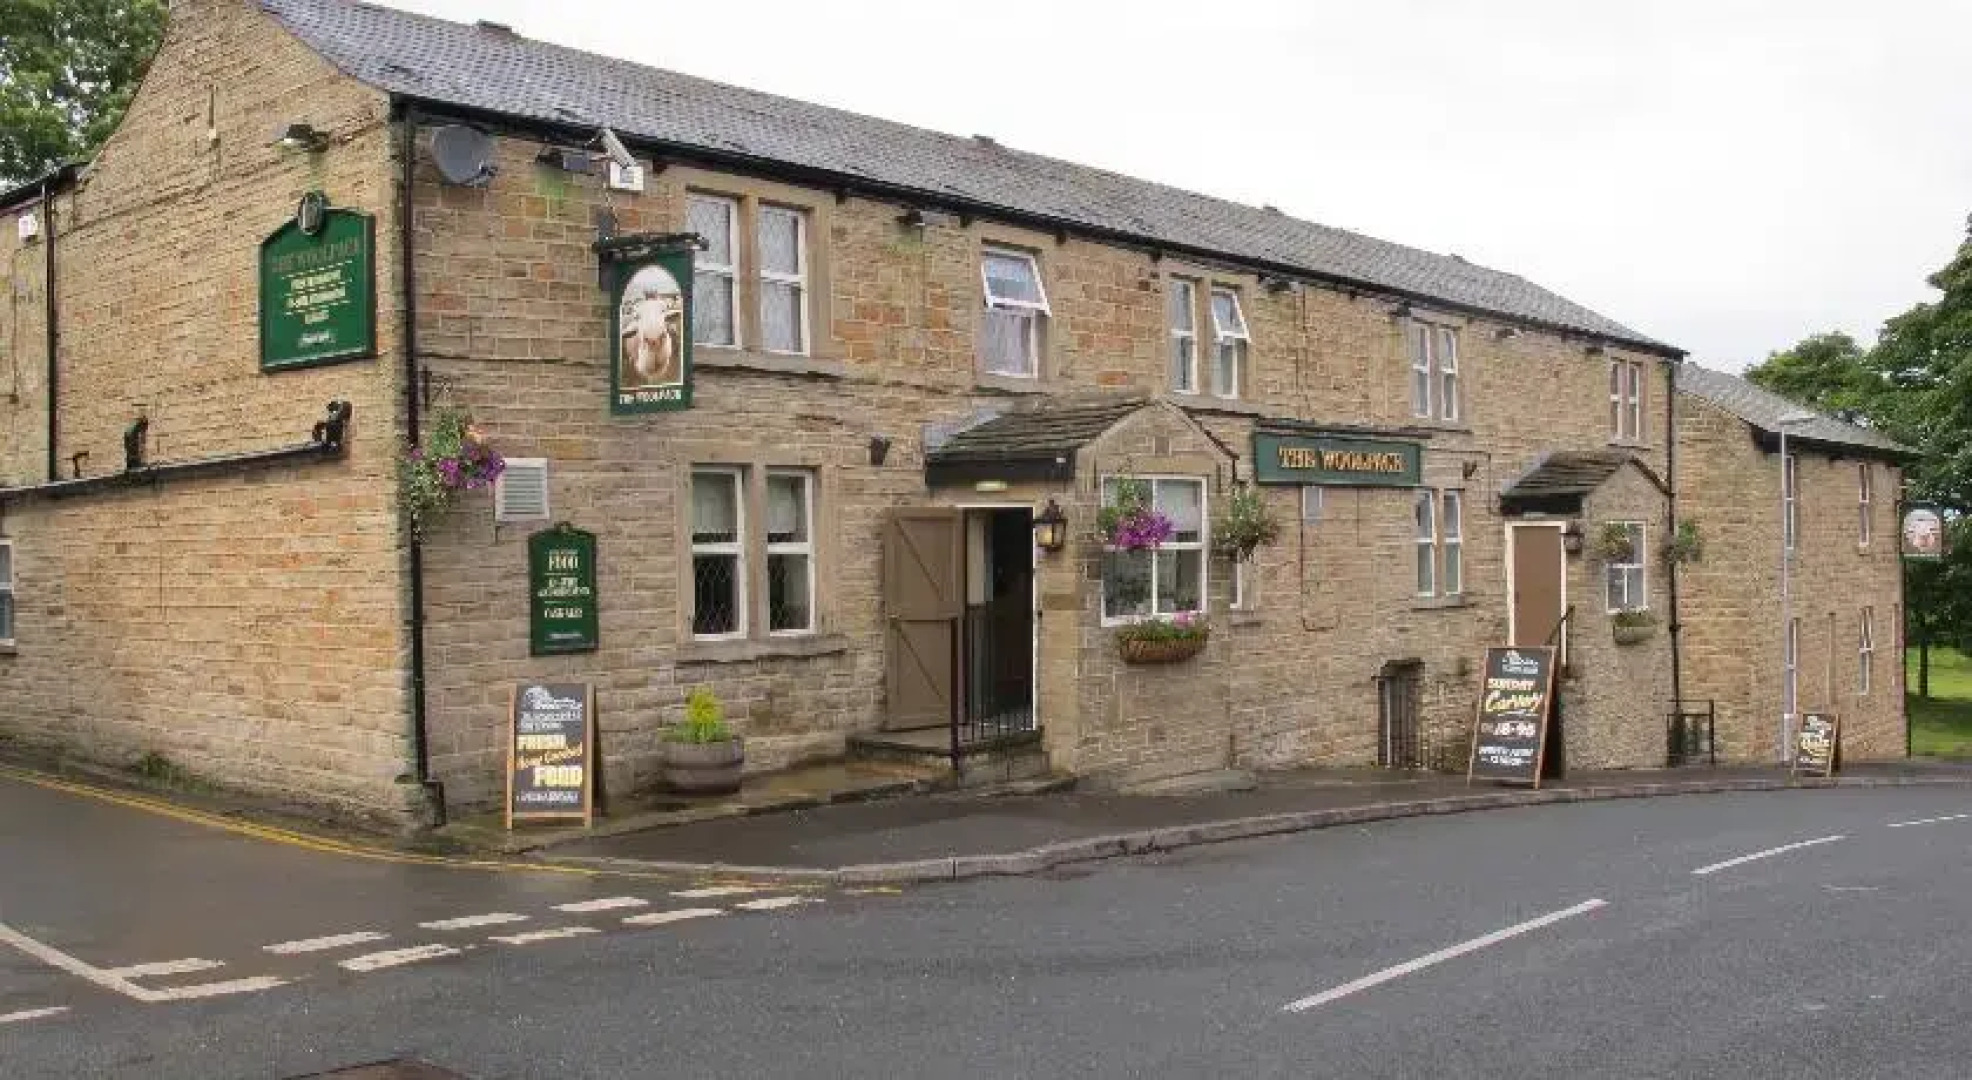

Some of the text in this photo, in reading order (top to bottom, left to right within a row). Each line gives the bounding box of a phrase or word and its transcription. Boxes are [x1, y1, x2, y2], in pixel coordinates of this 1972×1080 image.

[1279, 445, 1407, 472] THE WOOLPACK
[533, 764, 583, 788] FOOD
